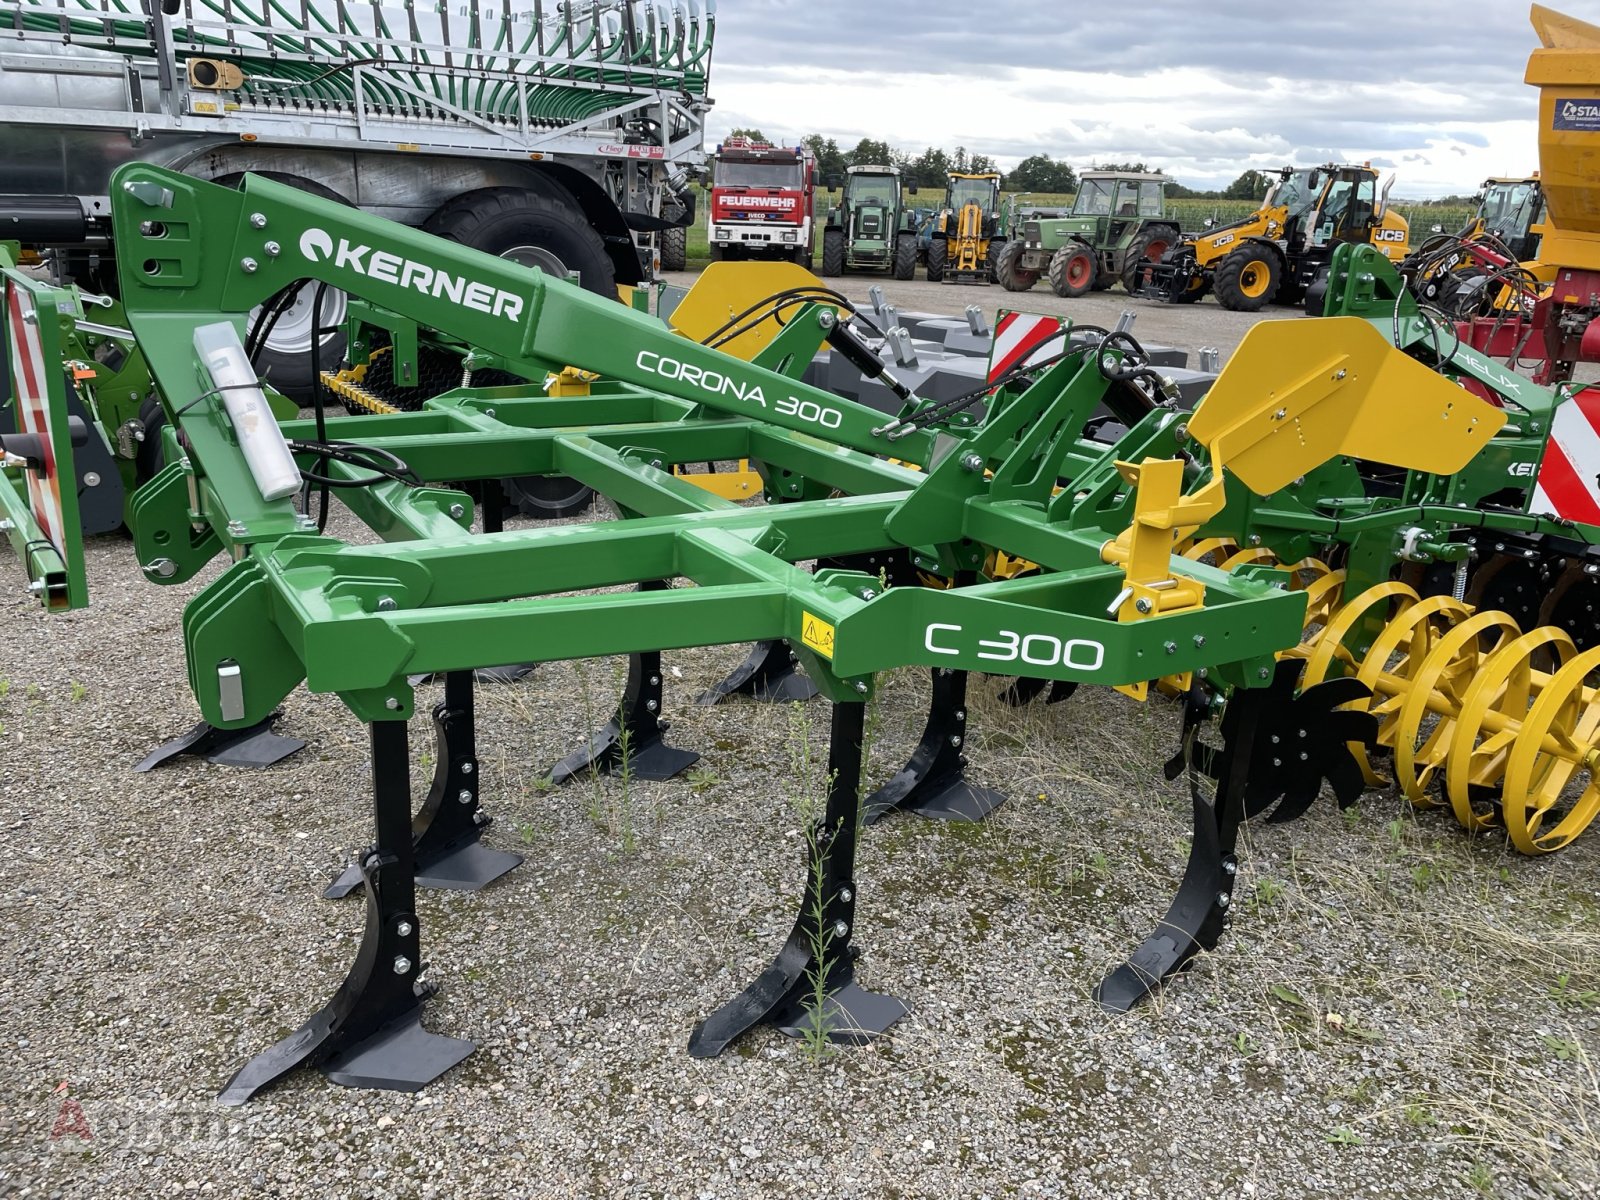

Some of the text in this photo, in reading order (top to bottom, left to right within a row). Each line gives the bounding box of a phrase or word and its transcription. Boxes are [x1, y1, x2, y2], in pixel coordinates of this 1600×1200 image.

[719, 196, 796, 208] FEUERWEHR
[1213, 234, 1234, 248] JCB
[1375, 230, 1405, 241] JCB
[335, 238, 524, 322] KERNER
[636, 350, 843, 429] CORONA 300
[925, 622, 1105, 671] C 300
